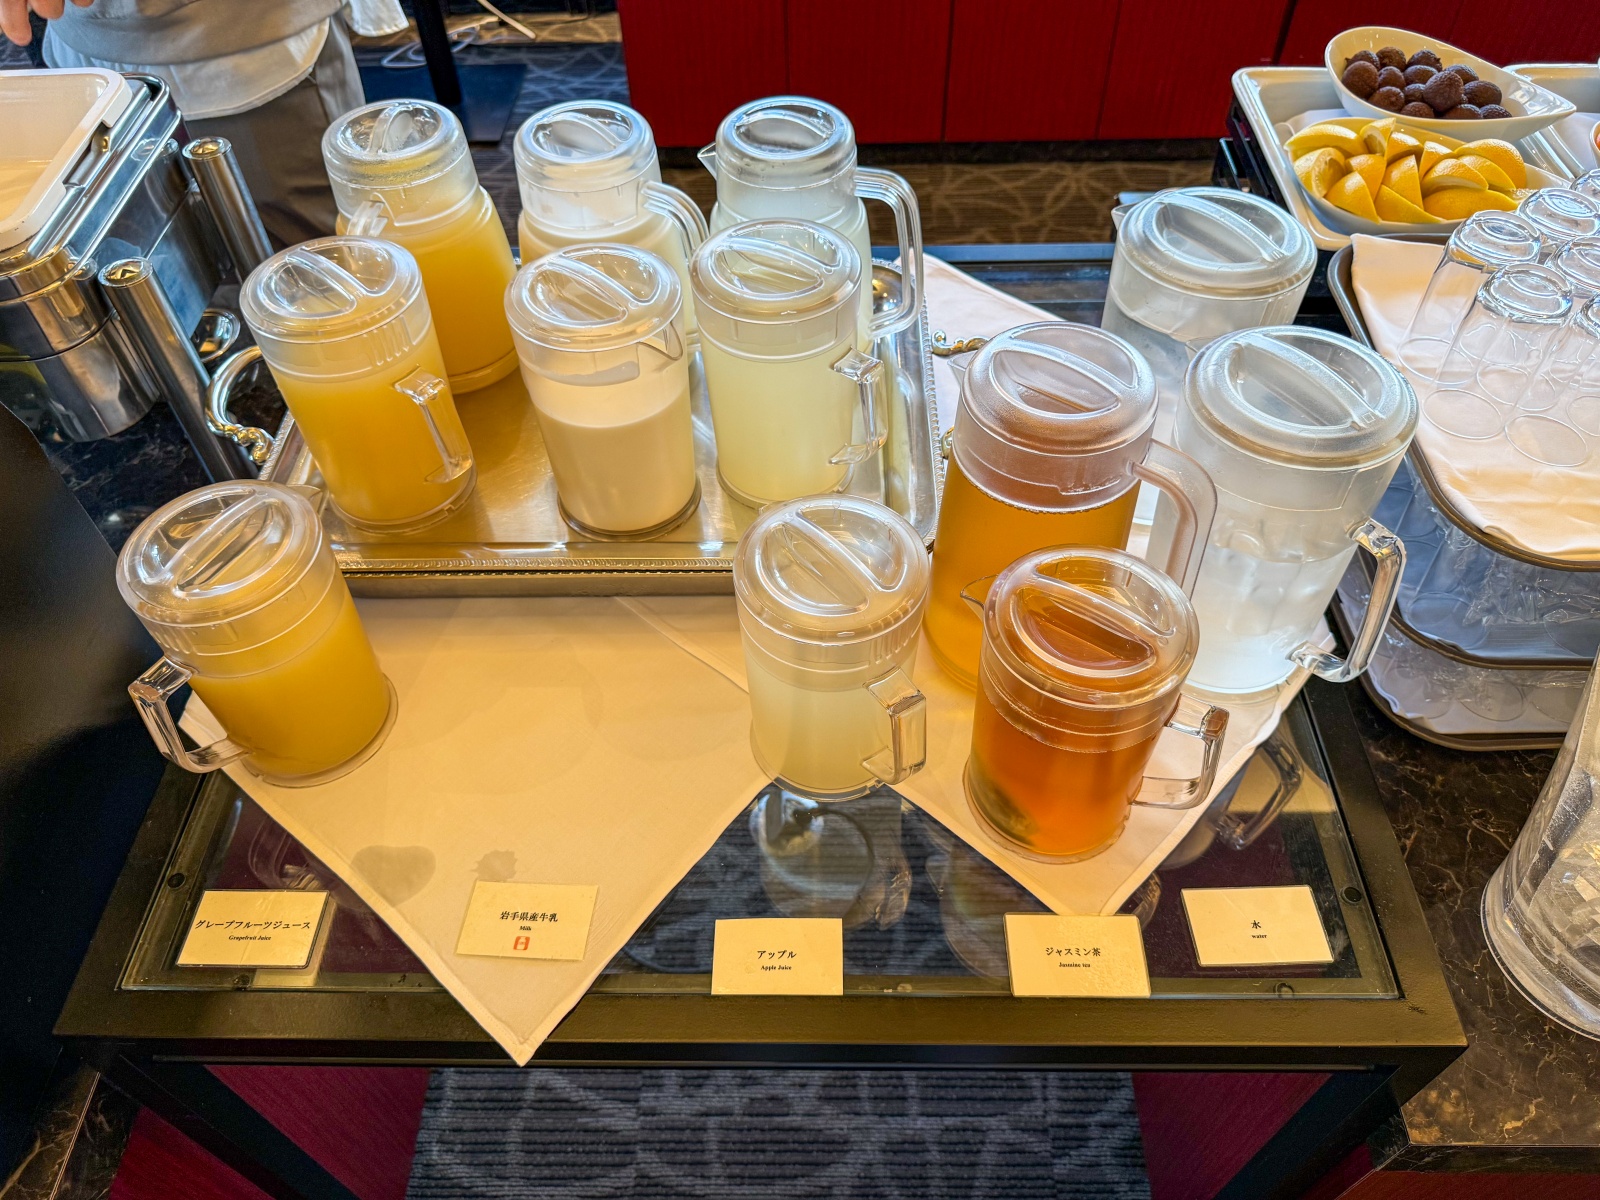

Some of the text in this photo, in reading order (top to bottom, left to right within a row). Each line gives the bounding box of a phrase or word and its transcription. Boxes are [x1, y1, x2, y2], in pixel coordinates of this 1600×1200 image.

[500, 910, 559, 923] 岩手県産牛乳
[195, 919, 311, 930] グレープフルーツジュース
[1250, 919, 1262, 930] 水
[228, 934, 257, 942] Grapefruit
[756, 949, 798, 960] アップル
[1045, 946, 1102, 957] ジャスミン茶
[760, 964, 777, 972] Apple
